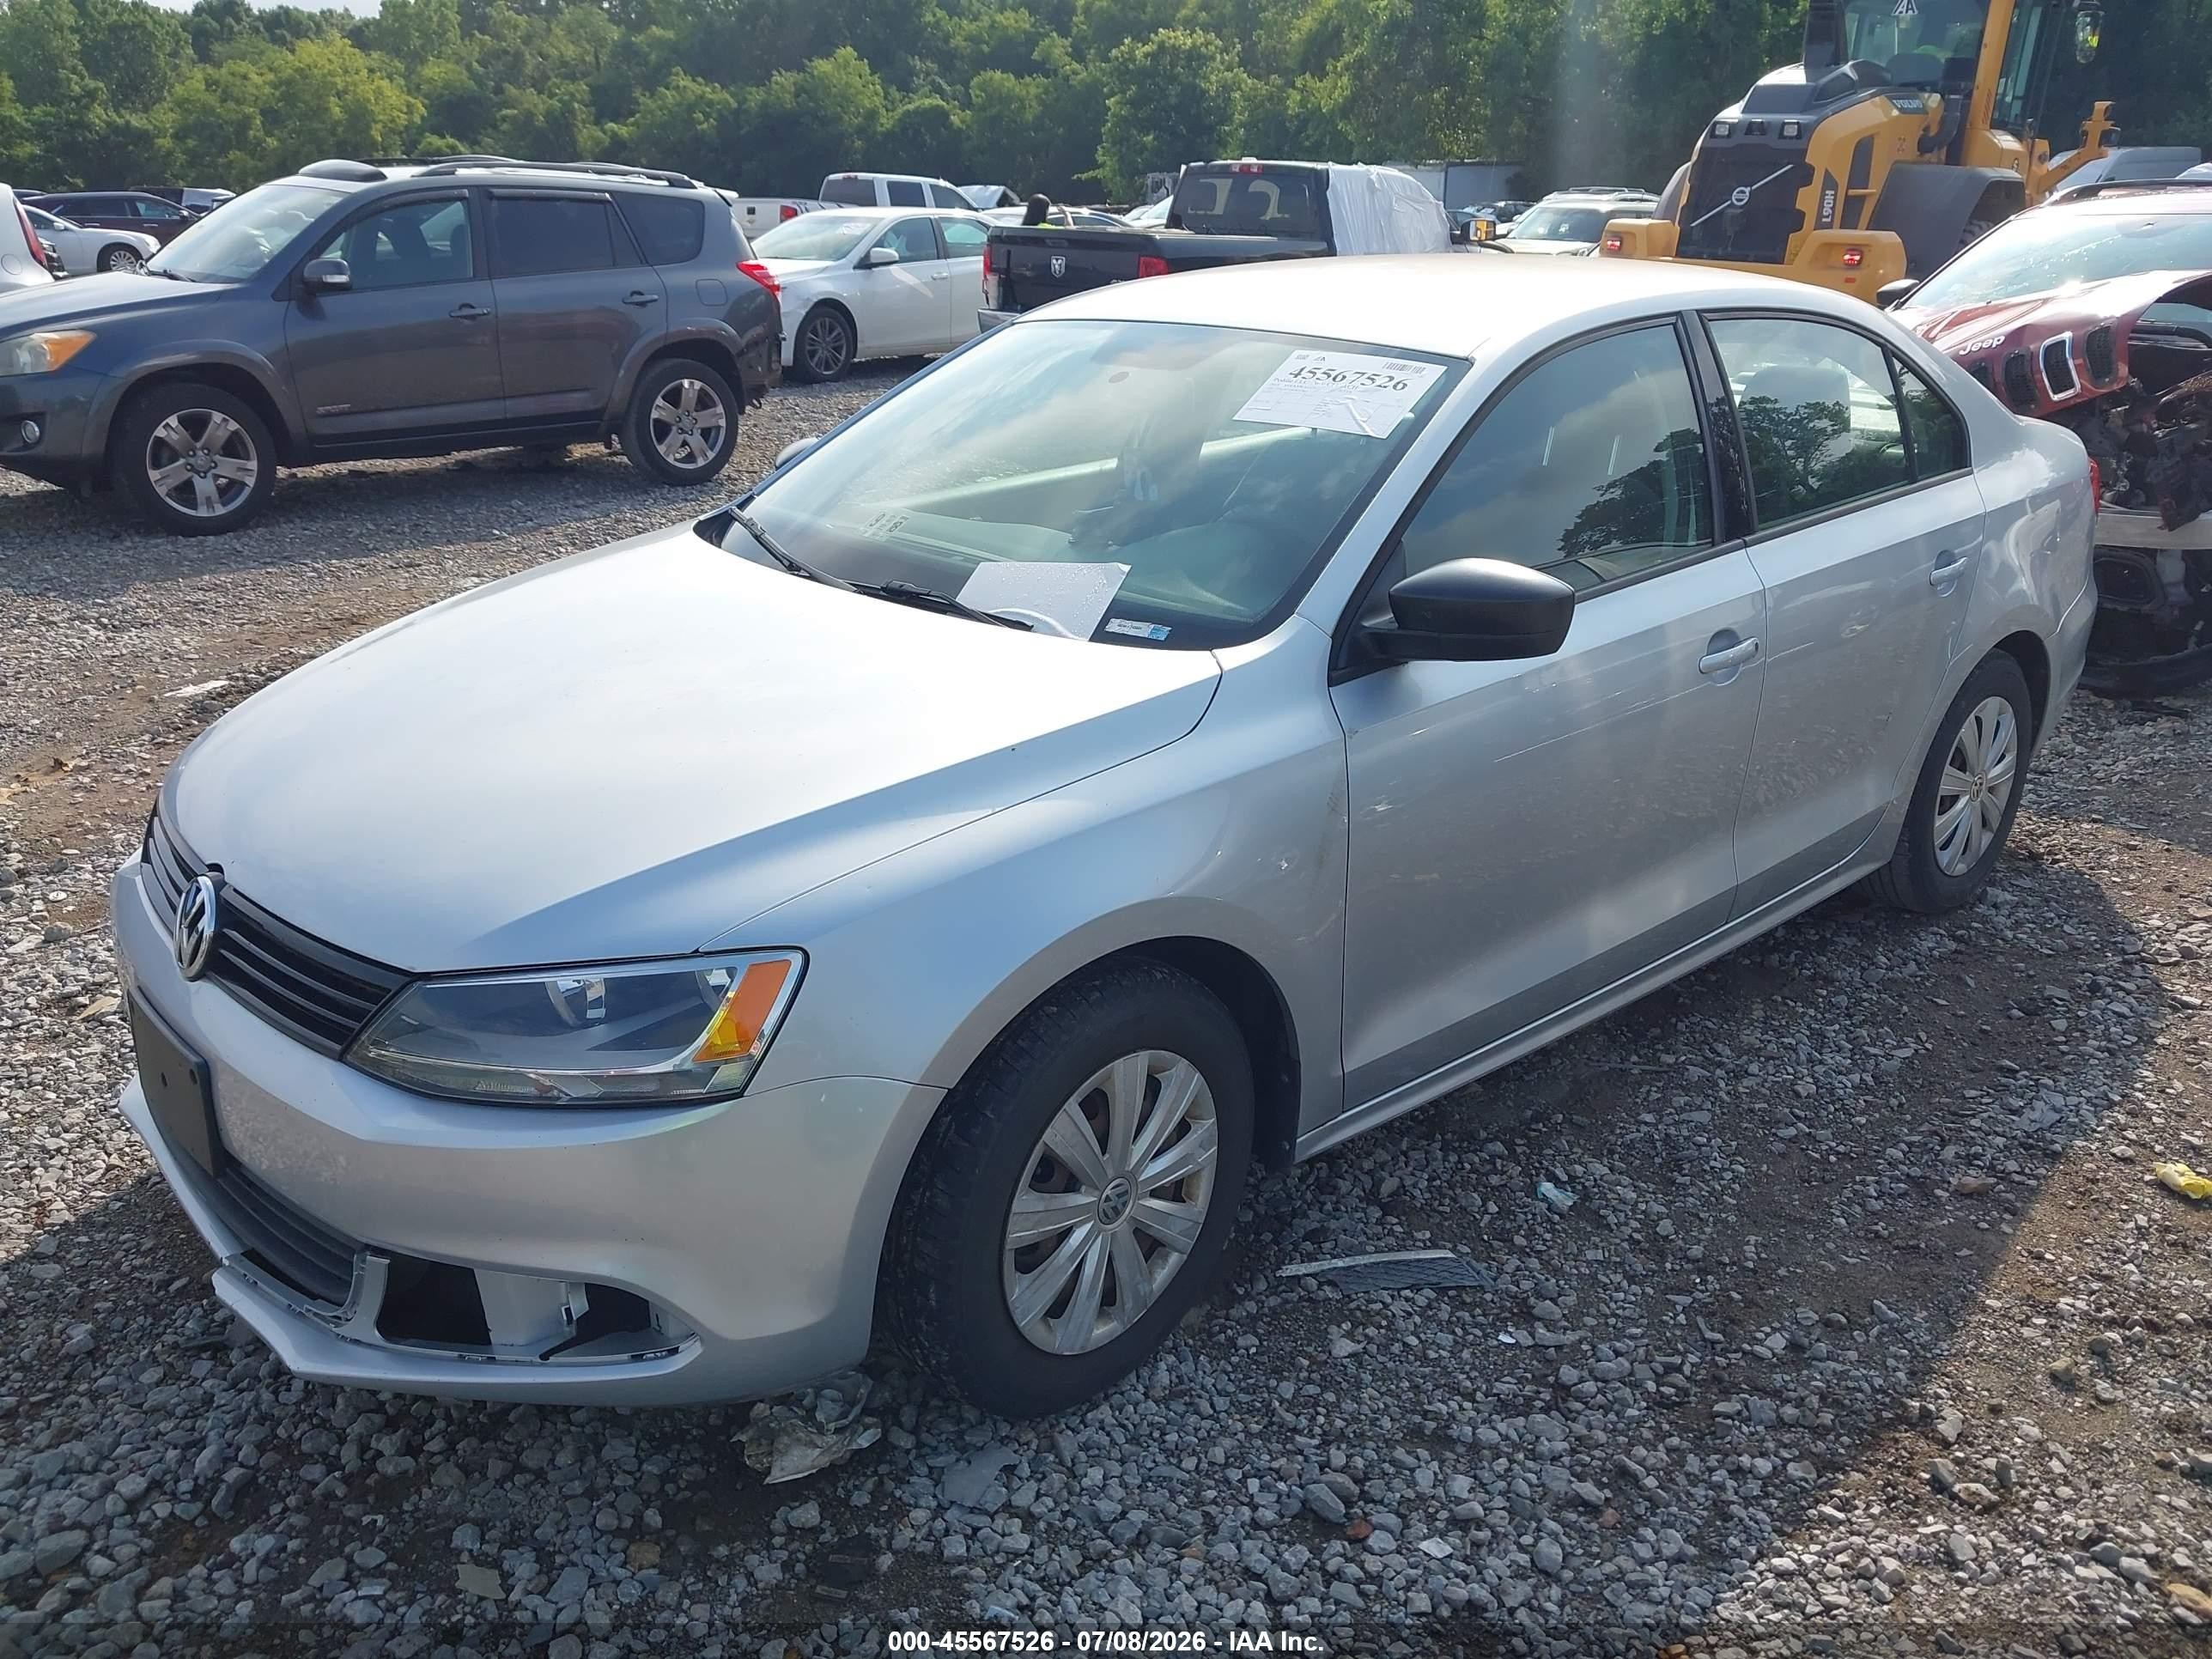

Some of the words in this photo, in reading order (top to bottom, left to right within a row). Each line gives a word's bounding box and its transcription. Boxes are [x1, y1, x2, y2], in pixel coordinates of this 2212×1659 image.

[1821, 190, 1835, 222] L90H
[1959, 336, 2005, 356] Jeep
[1289, 366, 1411, 392] 45567526
